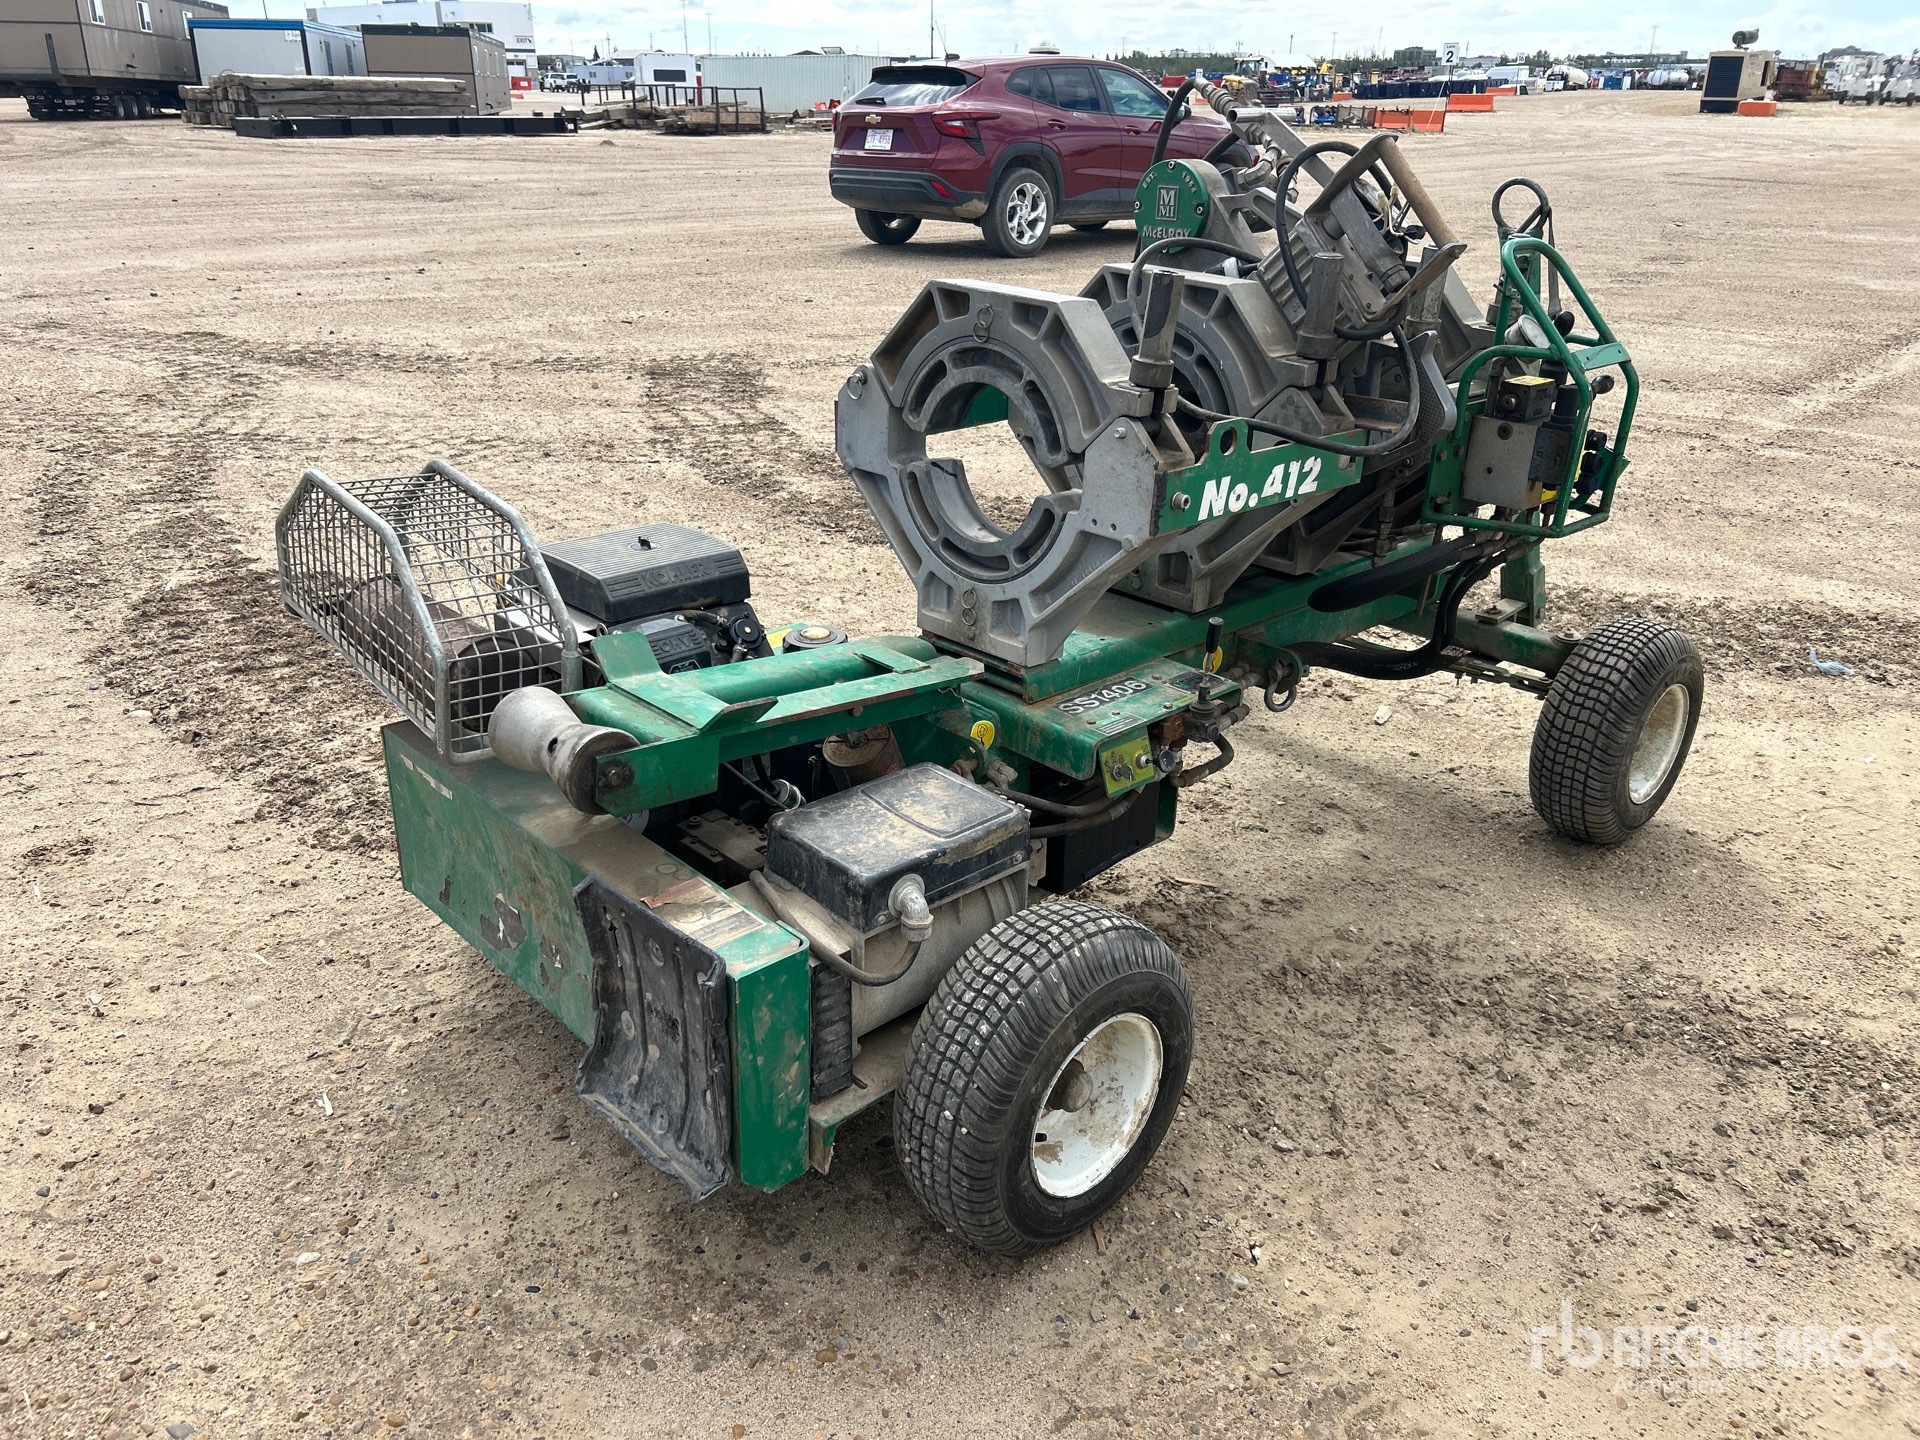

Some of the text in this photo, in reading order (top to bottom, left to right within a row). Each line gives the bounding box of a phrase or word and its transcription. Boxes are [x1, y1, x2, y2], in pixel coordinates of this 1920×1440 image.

[1445, 50, 1454, 63] 2
[1159, 189, 1176, 206] M
[1142, 224, 1192, 239] McELROY
[1197, 456, 1322, 521] No. 412
[641, 560, 713, 592] KOHLER
[1057, 680, 1148, 715] SS1406
